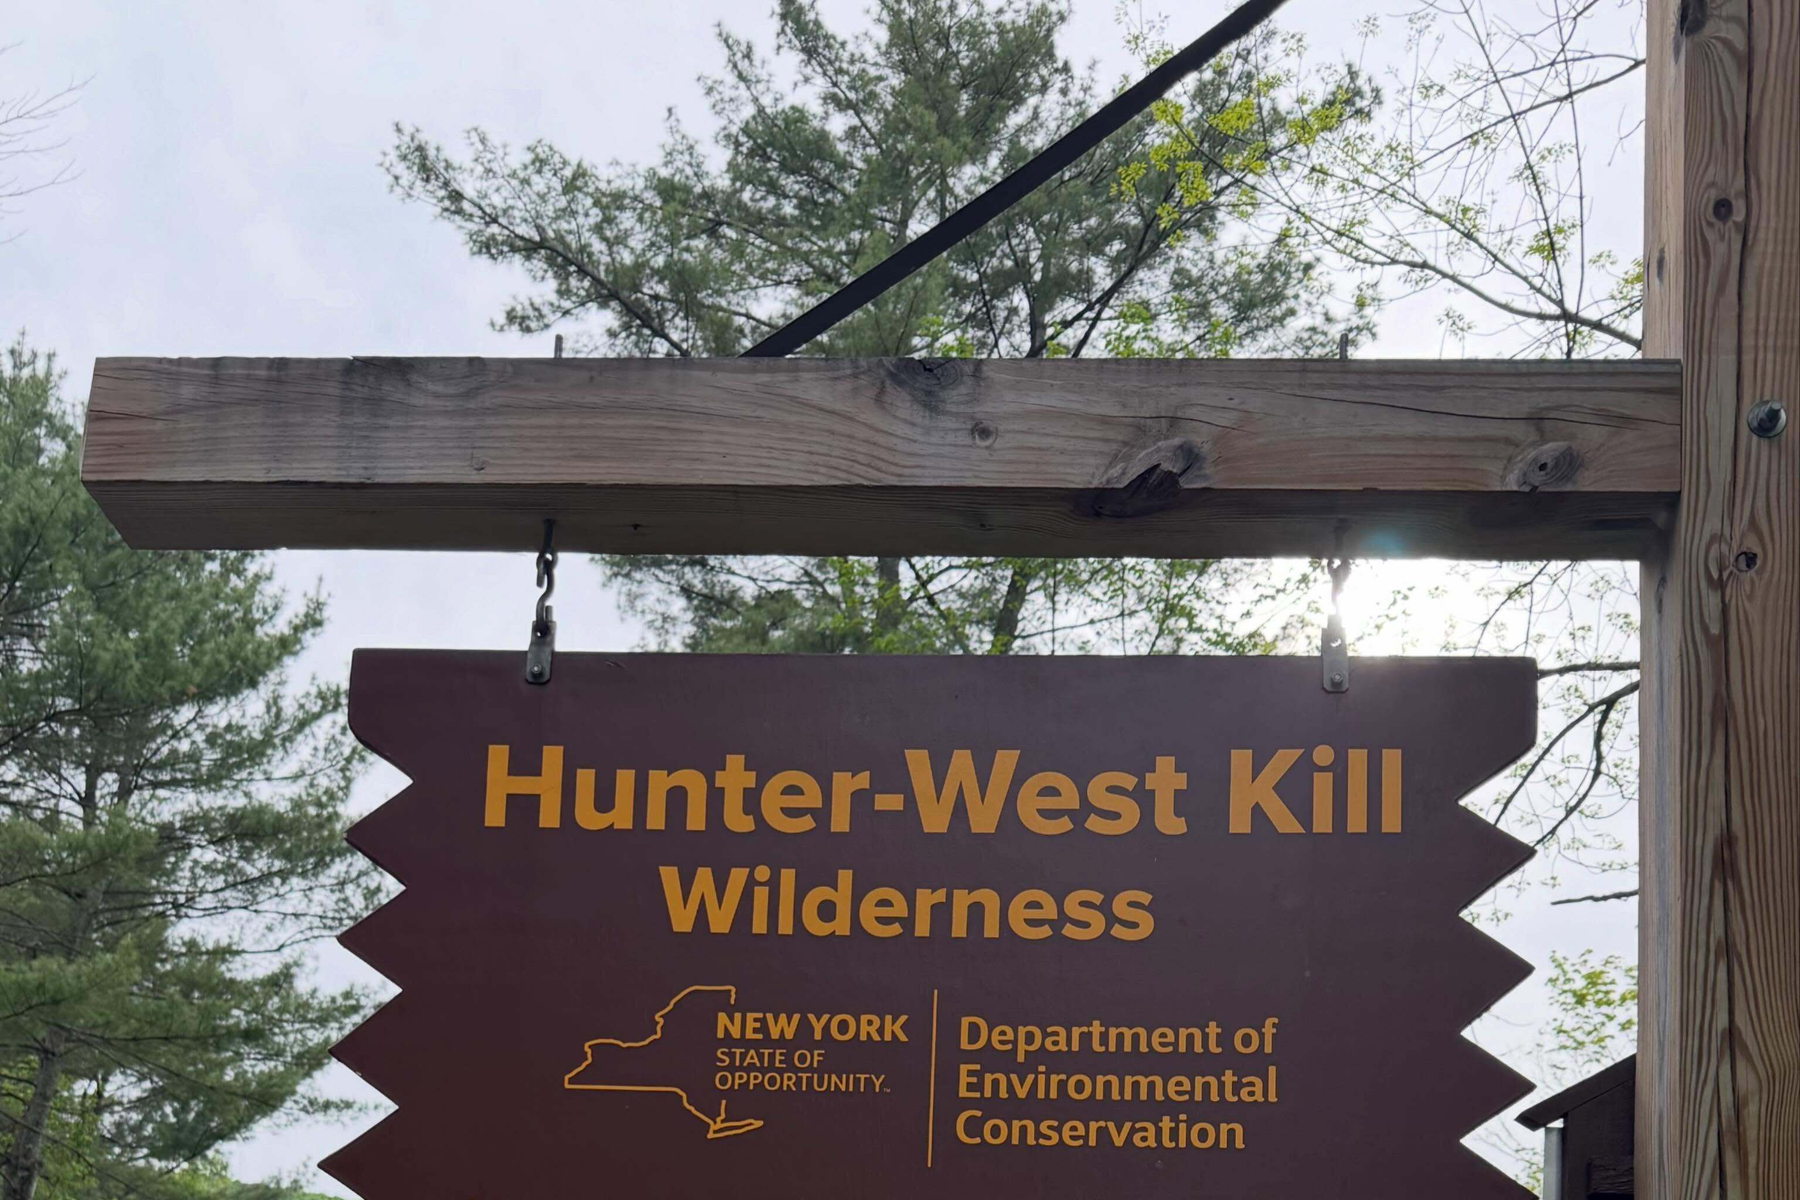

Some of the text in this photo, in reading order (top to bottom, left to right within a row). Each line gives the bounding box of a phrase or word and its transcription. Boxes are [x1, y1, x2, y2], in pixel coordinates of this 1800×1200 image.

[484, 745, 1401, 835] Hunter-West Kill
[659, 865, 1154, 941] Wilderness
[717, 1012, 908, 1042] NEW YORK
[960, 1016, 1278, 1063] Department of
[717, 1048, 824, 1068] STATE OF
[715, 1072, 885, 1092] OPPORTUNITY
[959, 1064, 1277, 1102] Environmental
[956, 1110, 1244, 1149] Conservation
